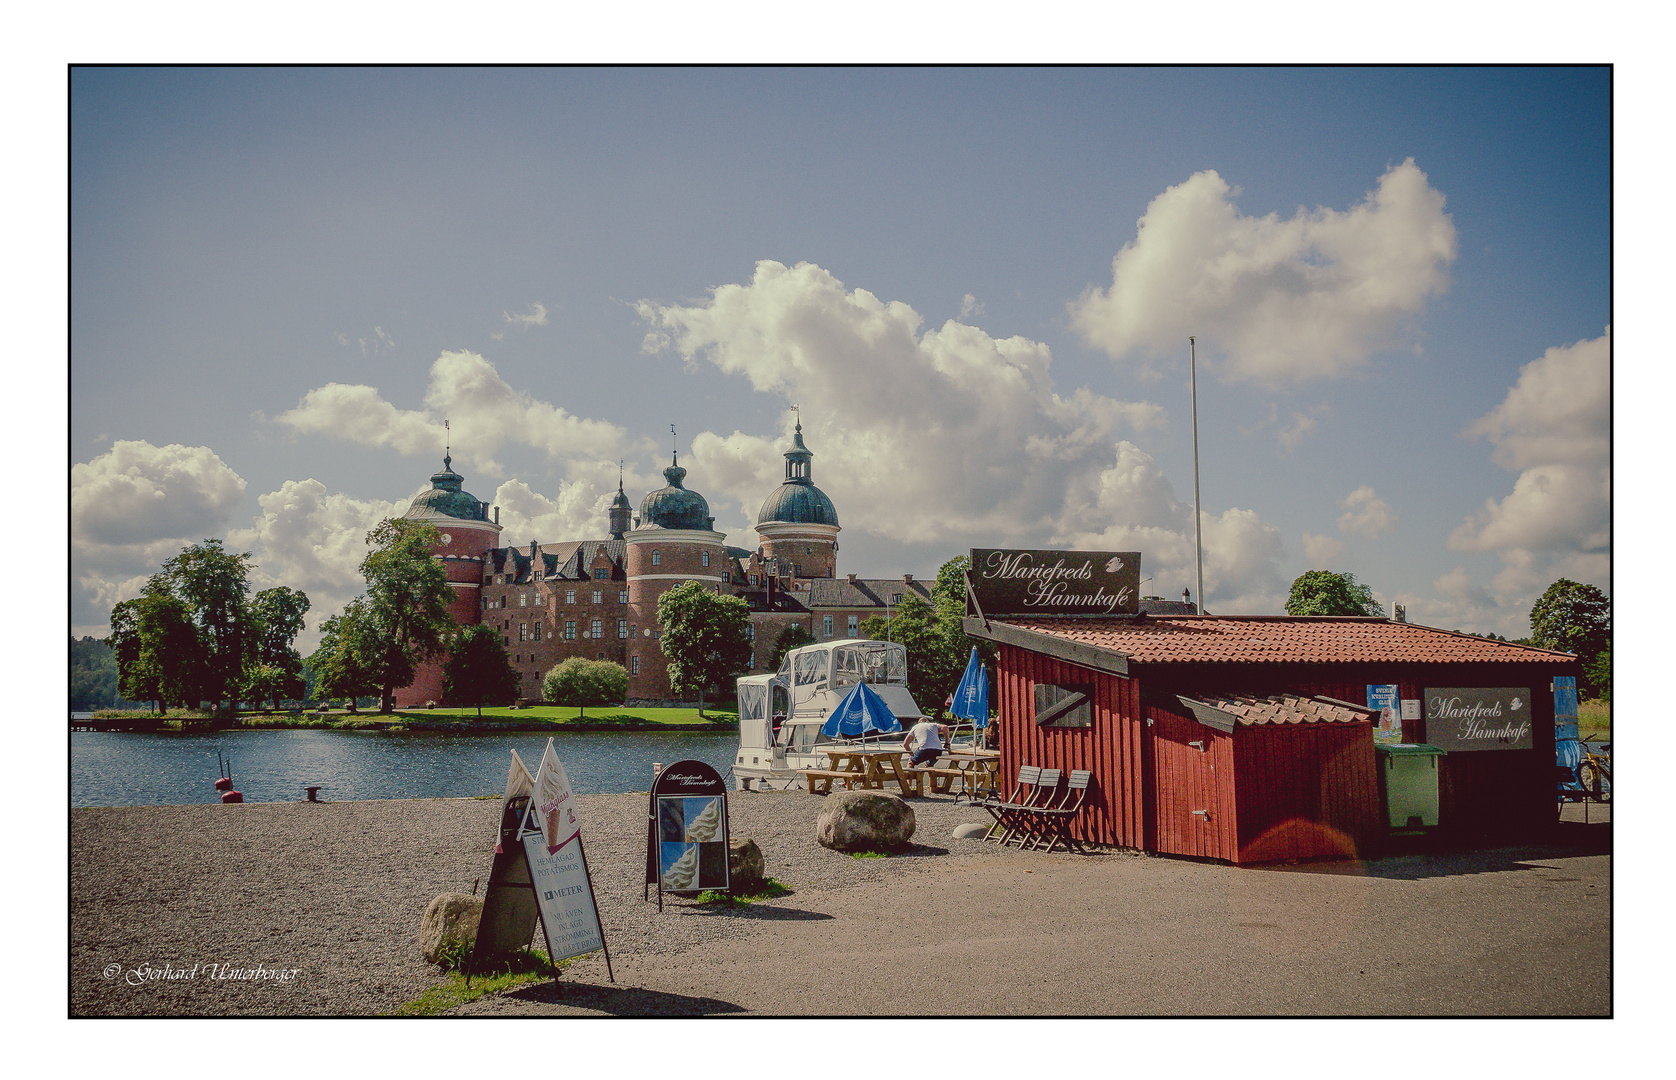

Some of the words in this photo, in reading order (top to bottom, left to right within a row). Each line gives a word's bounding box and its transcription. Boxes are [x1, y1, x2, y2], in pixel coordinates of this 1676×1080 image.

[982, 551, 1093, 586] Mariefreds
[1023, 579, 1134, 614] Hamnkafé
[1428, 697, 1502, 722] Mariefreds
[1457, 718, 1531, 744] Hamnkafé
[536, 853, 575, 867] HEMLAGAD
[537, 863, 579, 877] POTATISMOS
[554, 885, 583, 898] METER
